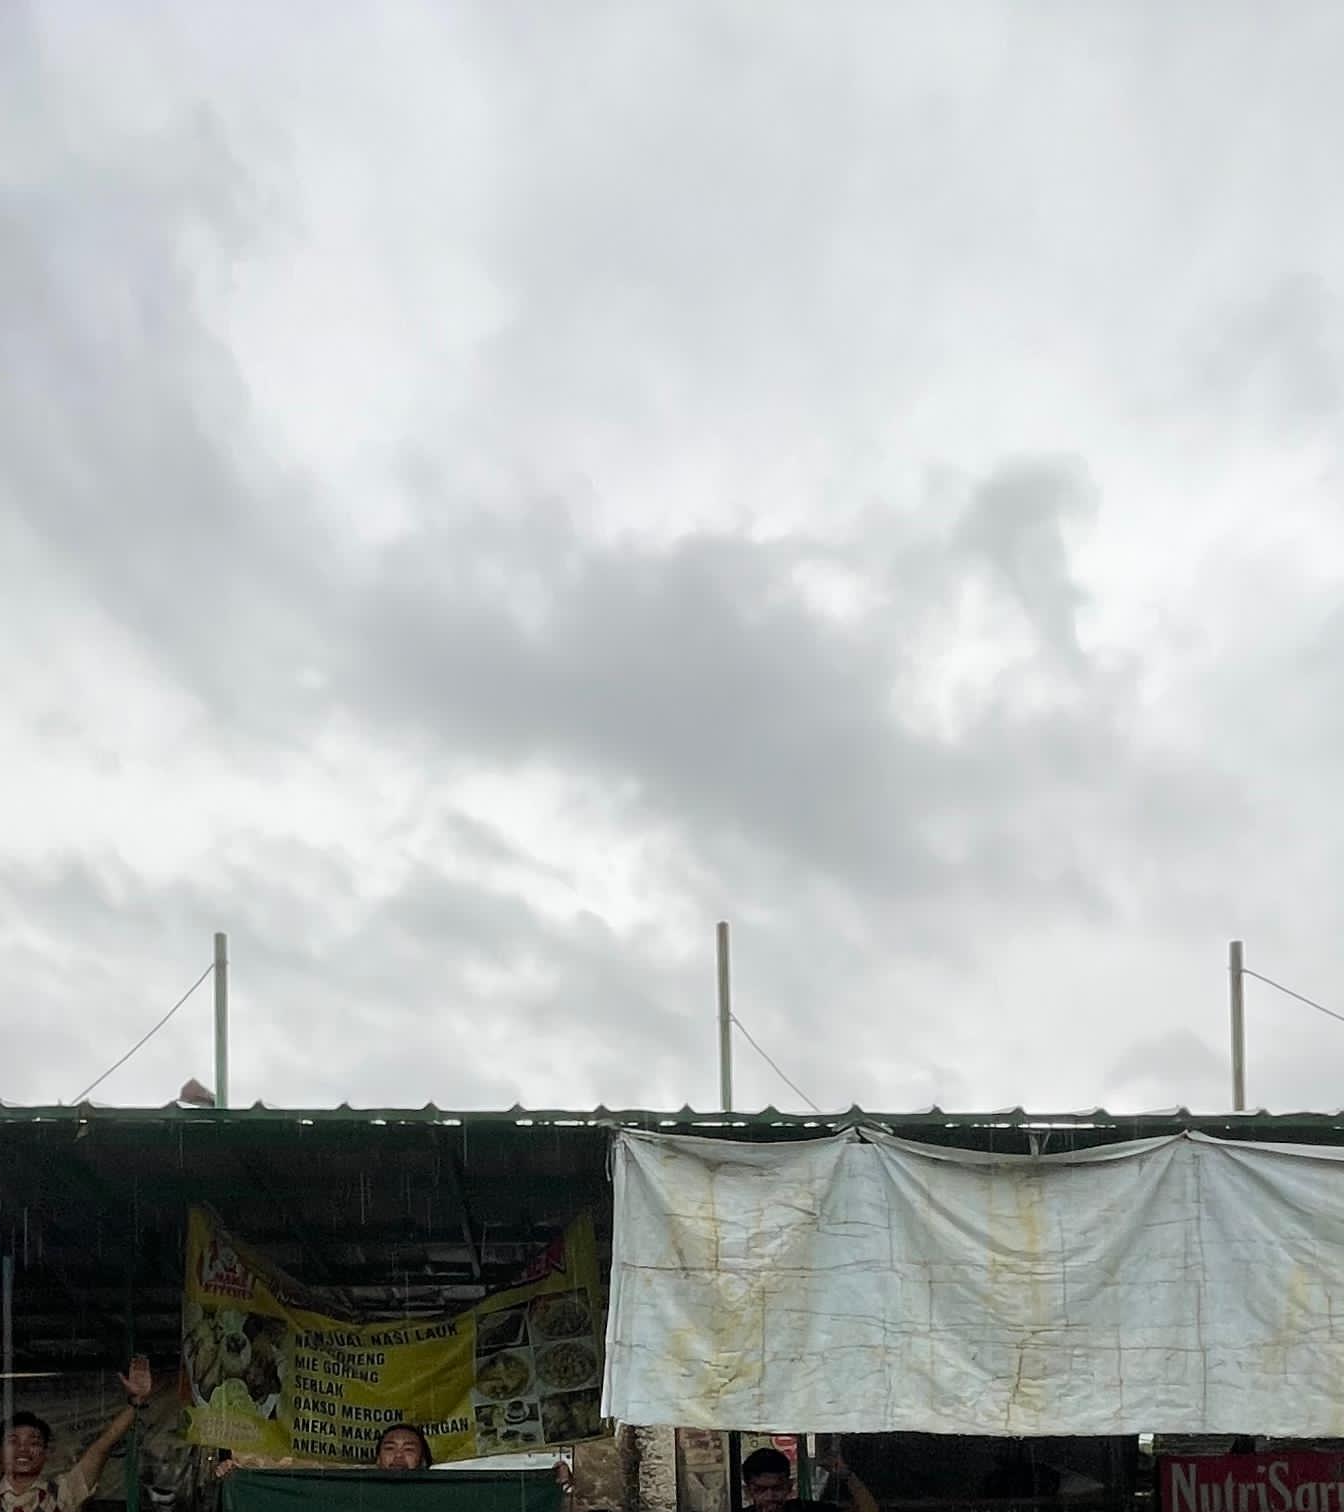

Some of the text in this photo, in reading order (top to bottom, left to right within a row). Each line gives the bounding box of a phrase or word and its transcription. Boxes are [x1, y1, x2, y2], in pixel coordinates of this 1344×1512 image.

[370, 1330, 408, 1346] NASI
[415, 1322, 458, 1342] LAUK
[295, 1355, 319, 1371] MIE
[295, 1375, 343, 1398] SEBLAK
[293, 1396, 336, 1416] BAKSO
[293, 1417, 337, 1437] ANEKA
[342, 1426, 385, 1442] MAKA
[293, 1438, 337, 1457] ANEKA
